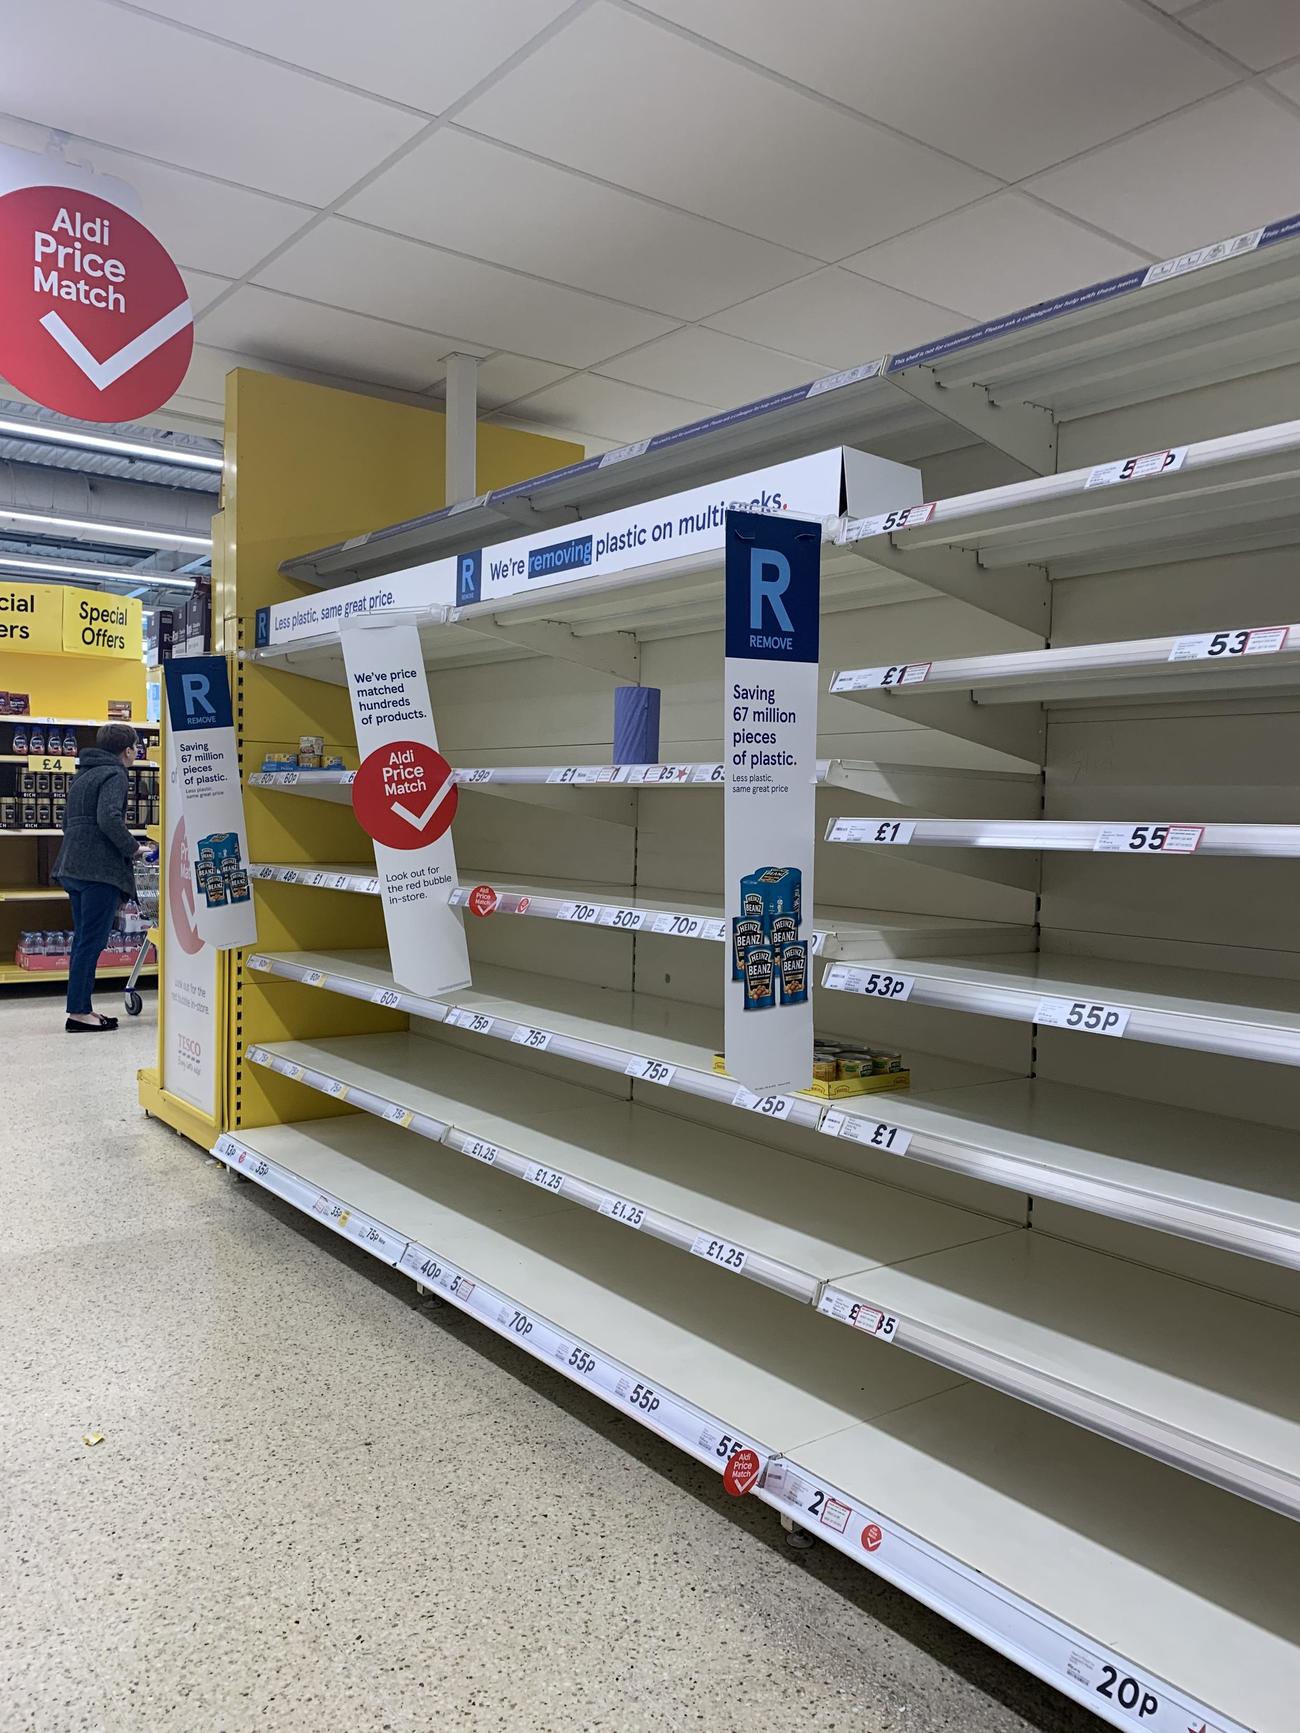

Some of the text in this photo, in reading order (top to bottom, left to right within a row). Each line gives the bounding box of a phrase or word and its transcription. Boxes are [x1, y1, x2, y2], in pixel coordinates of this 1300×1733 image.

[52, 208, 110, 246] Aldi
[34, 231, 126, 283] Price
[33, 266, 125, 314] Match
[1120, 453, 1176, 480] 5p
[882, 509, 909, 531] 55
[490, 489, 787, 581] We're removing plastic on multicks.
[462, 558, 475, 593] R
[750, 547, 795, 632] R
[79, 600, 128, 627] Special
[275, 590, 395, 631] Less plastic, same great price.
[259, 612, 266, 638] R
[81, 627, 125, 650] Offers
[749, 634, 793, 651] REMOVE
[1208, 631, 1249, 656] 53
[354, 668, 417, 684] We've price
[181, 672, 216, 715] R
[356, 683, 405, 698] matched
[733, 684, 775, 704] Saving
[358, 697, 411, 712] hundreds
[186, 715, 216, 725] REMOVE
[361, 710, 427, 726] of products.
[733, 706, 796, 724] 67 million
[180, 742, 209, 752] Saving
[732, 729, 776, 748] pieces
[42, 758, 63, 771] £4
[181, 752, 224, 763] 67 million
[389, 750, 414, 766] Aldi
[732, 750, 797, 769] of plastic.
[183, 765, 213, 776] pieces
[184, 773, 228, 786] of plastic.
[348, 772, 356, 783] 6
[382, 765, 424, 783] Price
[468, 769, 489, 783] 39p
[560, 768, 577, 783] £1
[732, 773, 774, 785] Less plastic,
[385, 780, 427, 797] Match
[732, 784, 789, 795] same great price
[875, 823, 901, 842] £1
[1129, 826, 1169, 850] 55
[386, 865, 440, 883] Look out for
[387, 874, 452, 893] the red bubble
[389, 891, 427, 904] in-store.
[570, 904, 595, 921] 70p
[745, 903, 761, 912] BEANZ
[612, 910, 640, 927] 50p
[668, 916, 697, 934] 70p
[740, 923, 758, 932] HEINZ
[776, 919, 793, 929] HEINZ
[737, 934, 760, 946] BEANZ
[773, 931, 794, 943] BEANZ
[751, 952, 769, 962] HEINZ
[785, 947, 803, 957] HEINZ
[748, 964, 771, 975] BEANZ
[784, 960, 804, 971] BEANZ
[864, 974, 905, 998] 53p
[379, 991, 398, 1006] 60p
[468, 1015, 489, 1032] 75p
[1066, 1003, 1120, 1031] 55p
[178, 1033, 201, 1057] TESCO
[523, 1029, 546, 1047] 75p
[641, 1060, 668, 1082] 75p
[870, 1123, 898, 1148] £1
[471, 1142, 496, 1162] £1.25
[534, 1168, 562, 1189] £1.25
[611, 1201, 644, 1225] £1.25
[366, 1227, 380, 1242] 75p
[706, 1241, 745, 1268] £1.25
[420, 1260, 441, 1280] 40p
[508, 1311, 533, 1335] 70p
[849, 1303, 896, 1335] £35
[568, 1347, 596, 1373] 55p
[629, 1384, 660, 1412] 55p
[716, 1435, 743, 1461] 55
[739, 1453, 752, 1461] Aldi
[732, 1469, 751, 1478] Match
[734, 1462, 753, 1470] Price
[807, 1490, 824, 1517] 2
[1095, 1665, 1159, 1718] 20p
